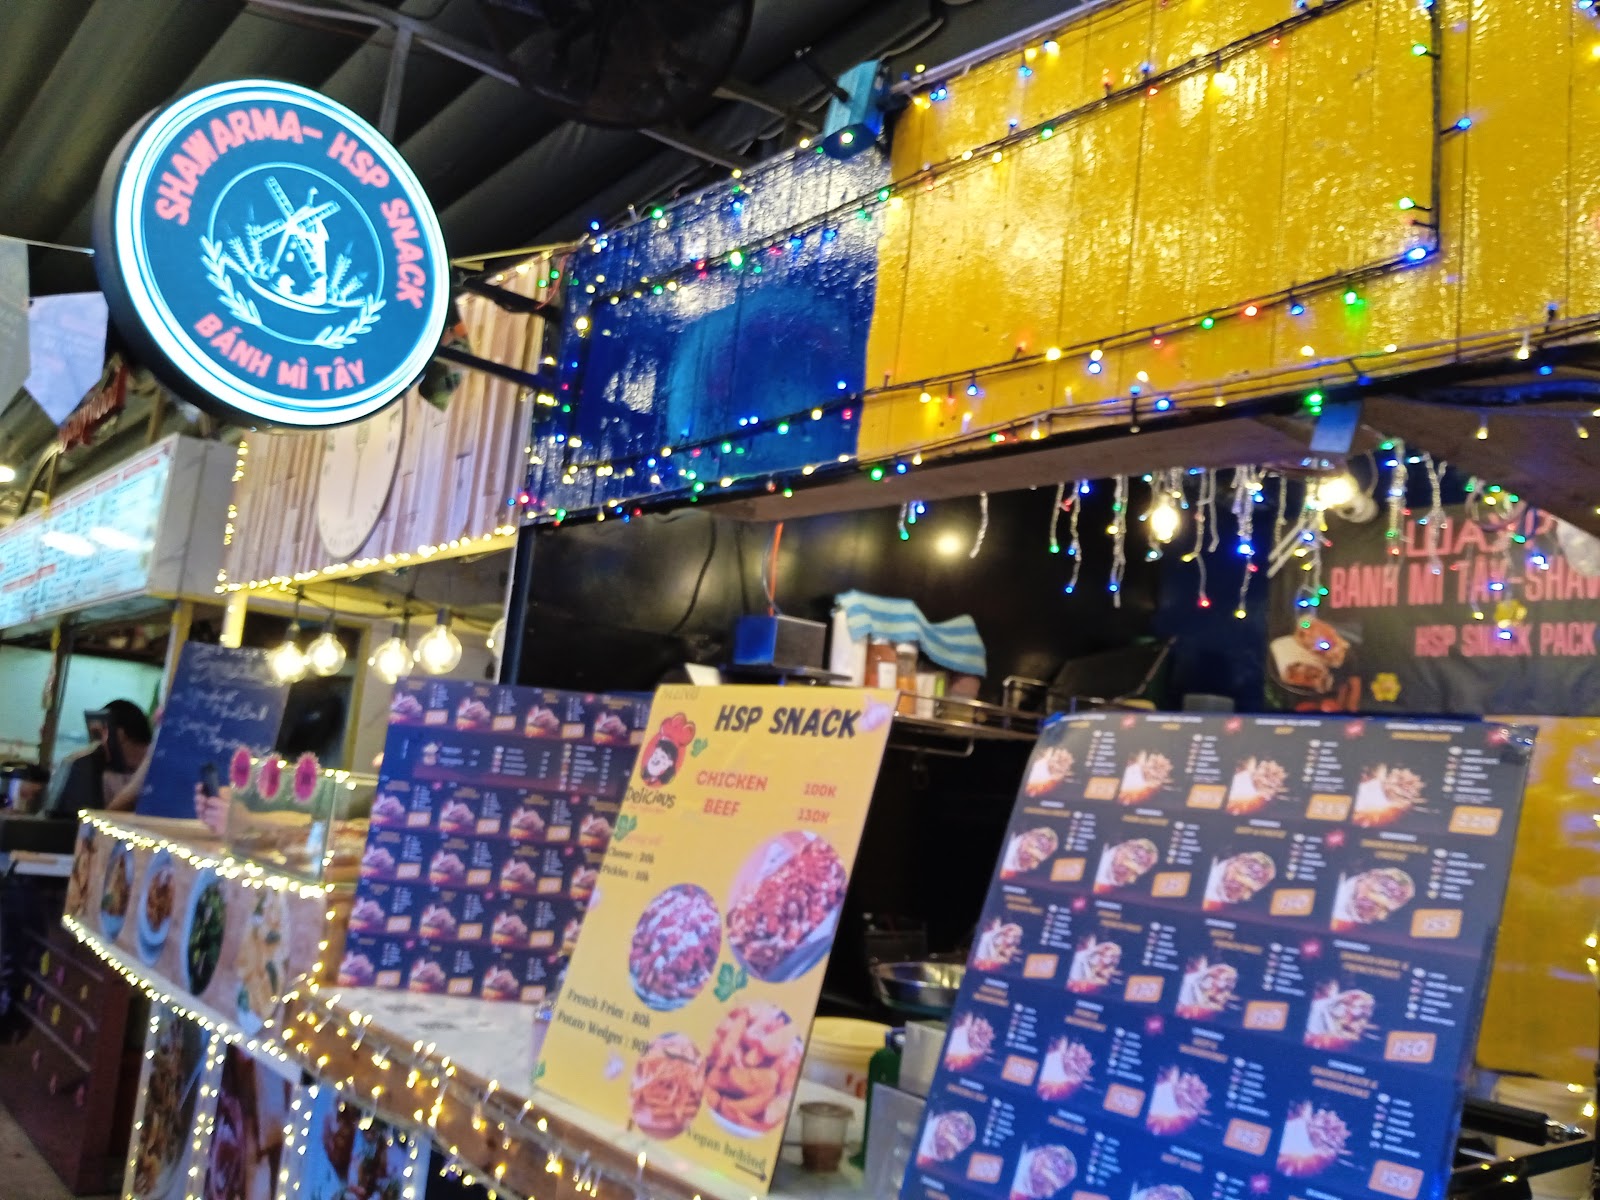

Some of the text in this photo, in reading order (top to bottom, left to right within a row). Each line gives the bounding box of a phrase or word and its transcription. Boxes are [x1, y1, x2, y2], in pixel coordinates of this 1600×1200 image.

[327, 131, 390, 188] HSP
[380, 198, 426, 309] SNACK
[194, 312, 365, 391] BÁNH MÌ TÂY
[1540, 621, 1598, 655] PACK
[714, 705, 861, 739] HSP SNACK
[695, 770, 768, 792] CHICKEN
[626, 787, 677, 809] Delicious
[702, 798, 741, 817] BEEF
[567, 988, 598, 1011] French
[599, 999, 625, 1020] Fries
[557, 1008, 586, 1031] Potato
[587, 1020, 624, 1045] Wedges
[723, 1139, 767, 1171] behind
